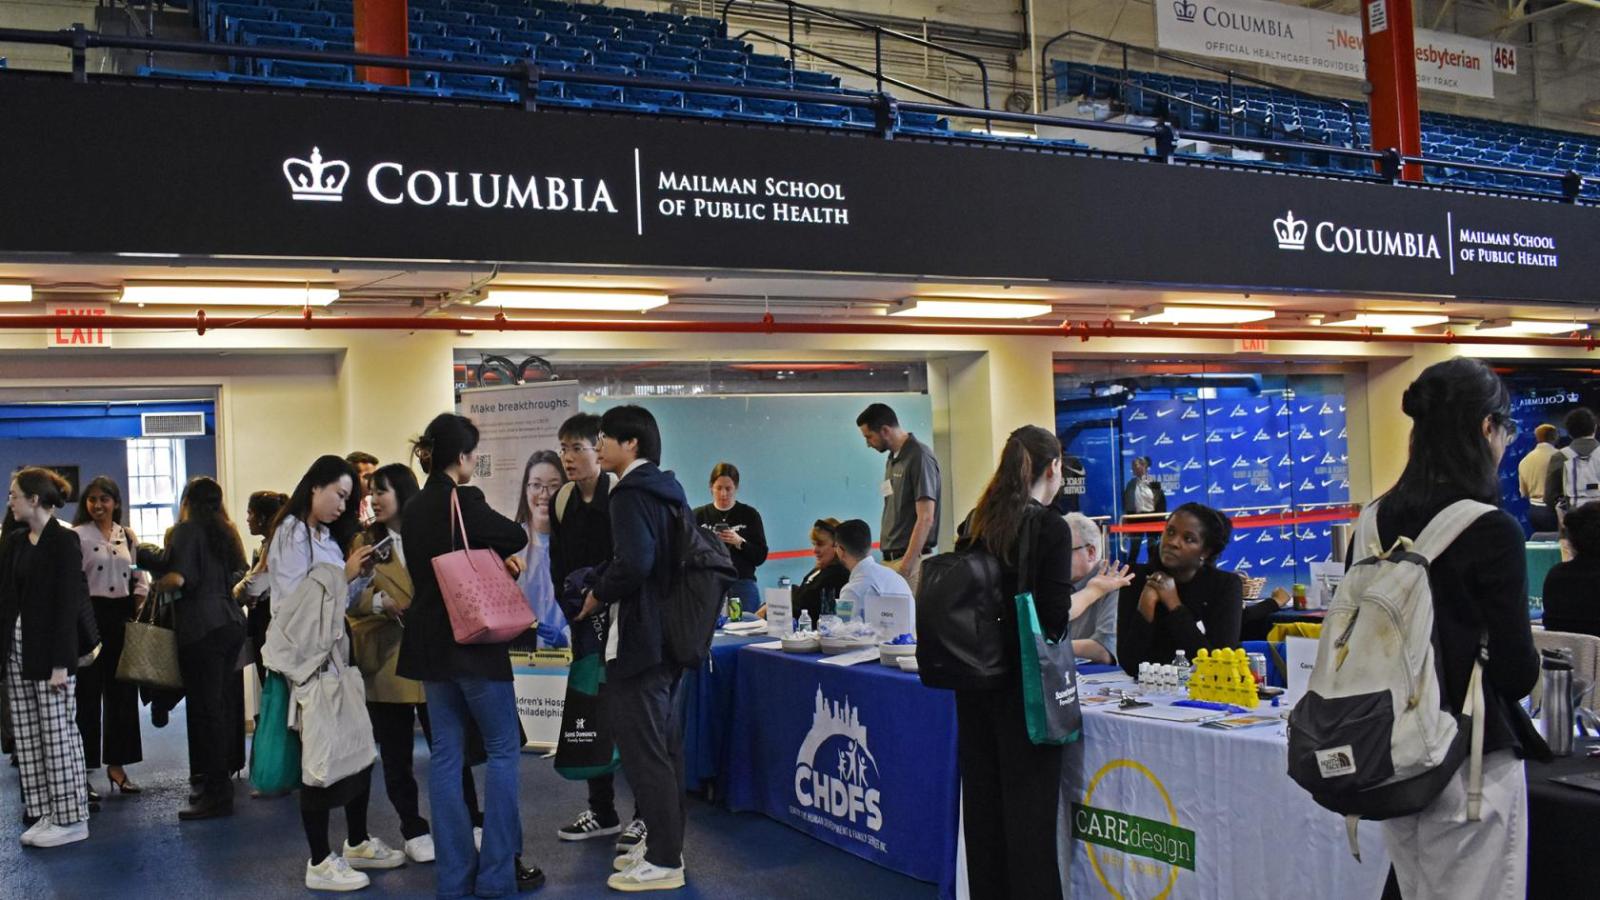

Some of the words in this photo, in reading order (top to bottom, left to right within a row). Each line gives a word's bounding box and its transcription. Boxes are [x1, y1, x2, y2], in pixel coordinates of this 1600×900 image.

[1203, 6, 1293, 39] COLUMBIA
[1205, 41, 1249, 55] OFFICIAL
[1253, 48, 1310, 65] HEALTHCARE
[1312, 57, 1360, 73] PROVIDERS
[1495, 46, 1515, 70] 464
[367, 161, 619, 213] COLUMBIA
[657, 170, 757, 195] MAILMAN
[765, 176, 846, 201] SCHOOL
[658, 198, 686, 216] OF
[693, 198, 766, 221] PUBLIC
[772, 202, 849, 225] HEALTH
[1315, 221, 1442, 260] COLUMBIA
[1459, 228, 1511, 246] MAILMAN
[1512, 232, 1556, 250] SCHOOL
[1460, 248, 1475, 262] OF
[1477, 247, 1516, 265] PUBLIC
[1517, 250, 1558, 267] HEALTH
[56, 308, 105, 344] EXIT
[470, 403, 496, 414] Make
[498, 397, 570, 413] breakthroughs.
[795, 765, 882, 832] CHDFS
[1076, 810, 1190, 863] CAREdesign
